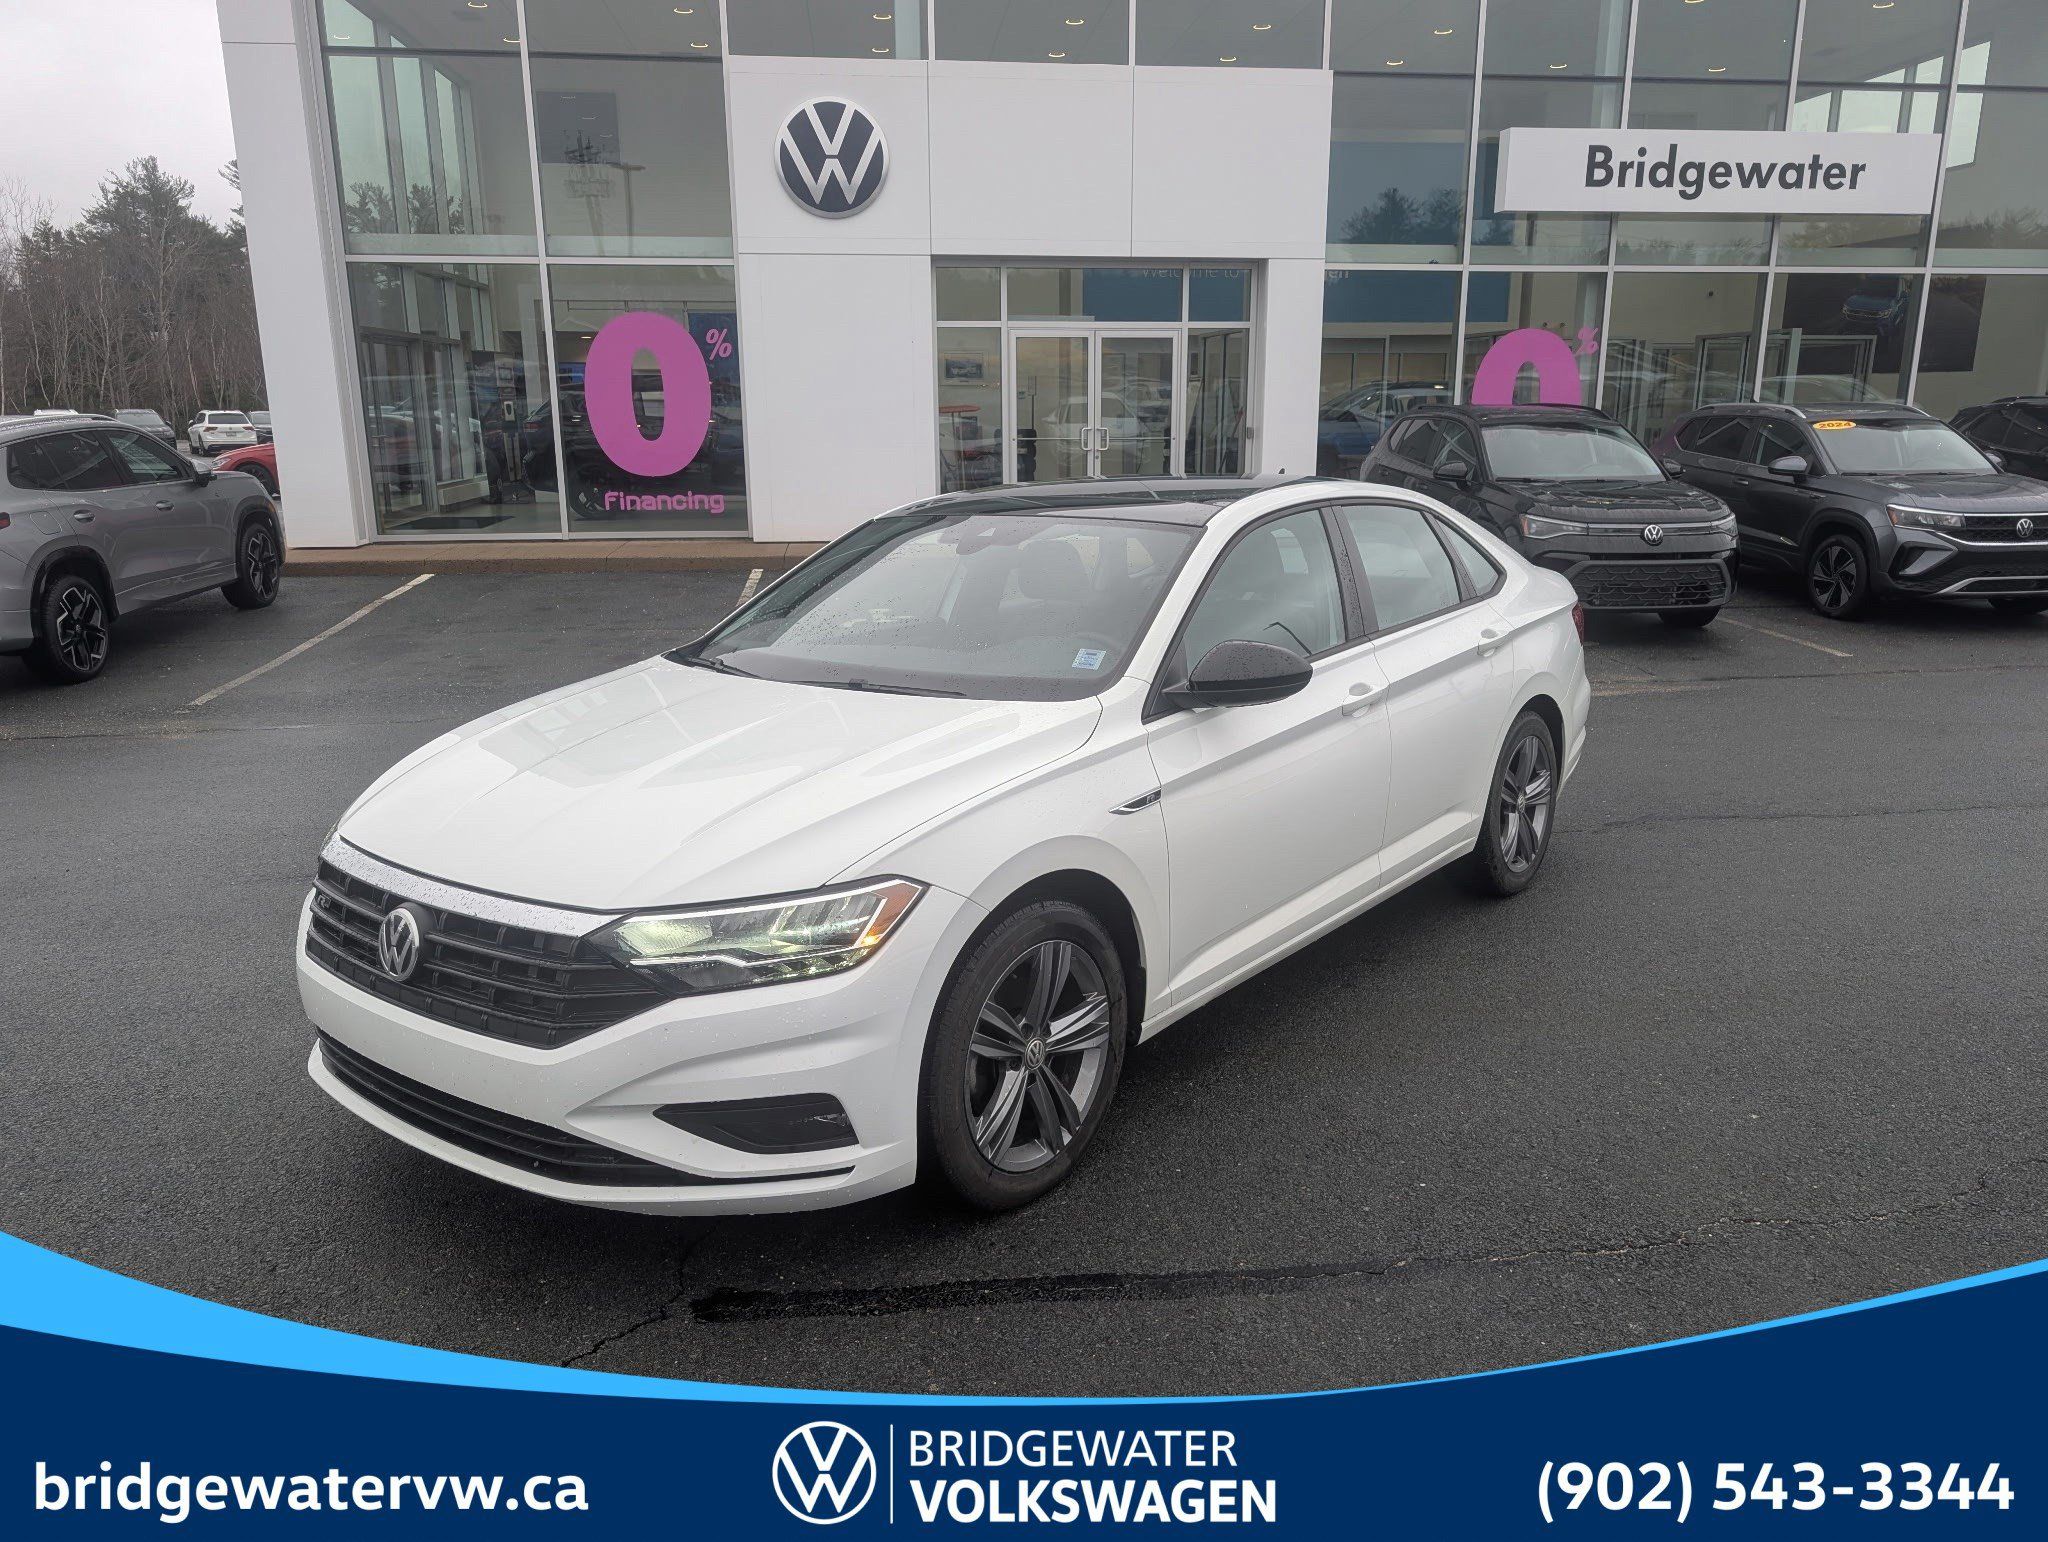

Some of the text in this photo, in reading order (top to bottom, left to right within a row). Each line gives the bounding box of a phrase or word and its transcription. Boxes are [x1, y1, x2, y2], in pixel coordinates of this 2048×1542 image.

[1585, 144, 1866, 200] Bridgewater
[1142, 269, 1217, 279] Welcme
[1818, 422, 1852, 430] 2024
[604, 491, 725, 514] Financing
